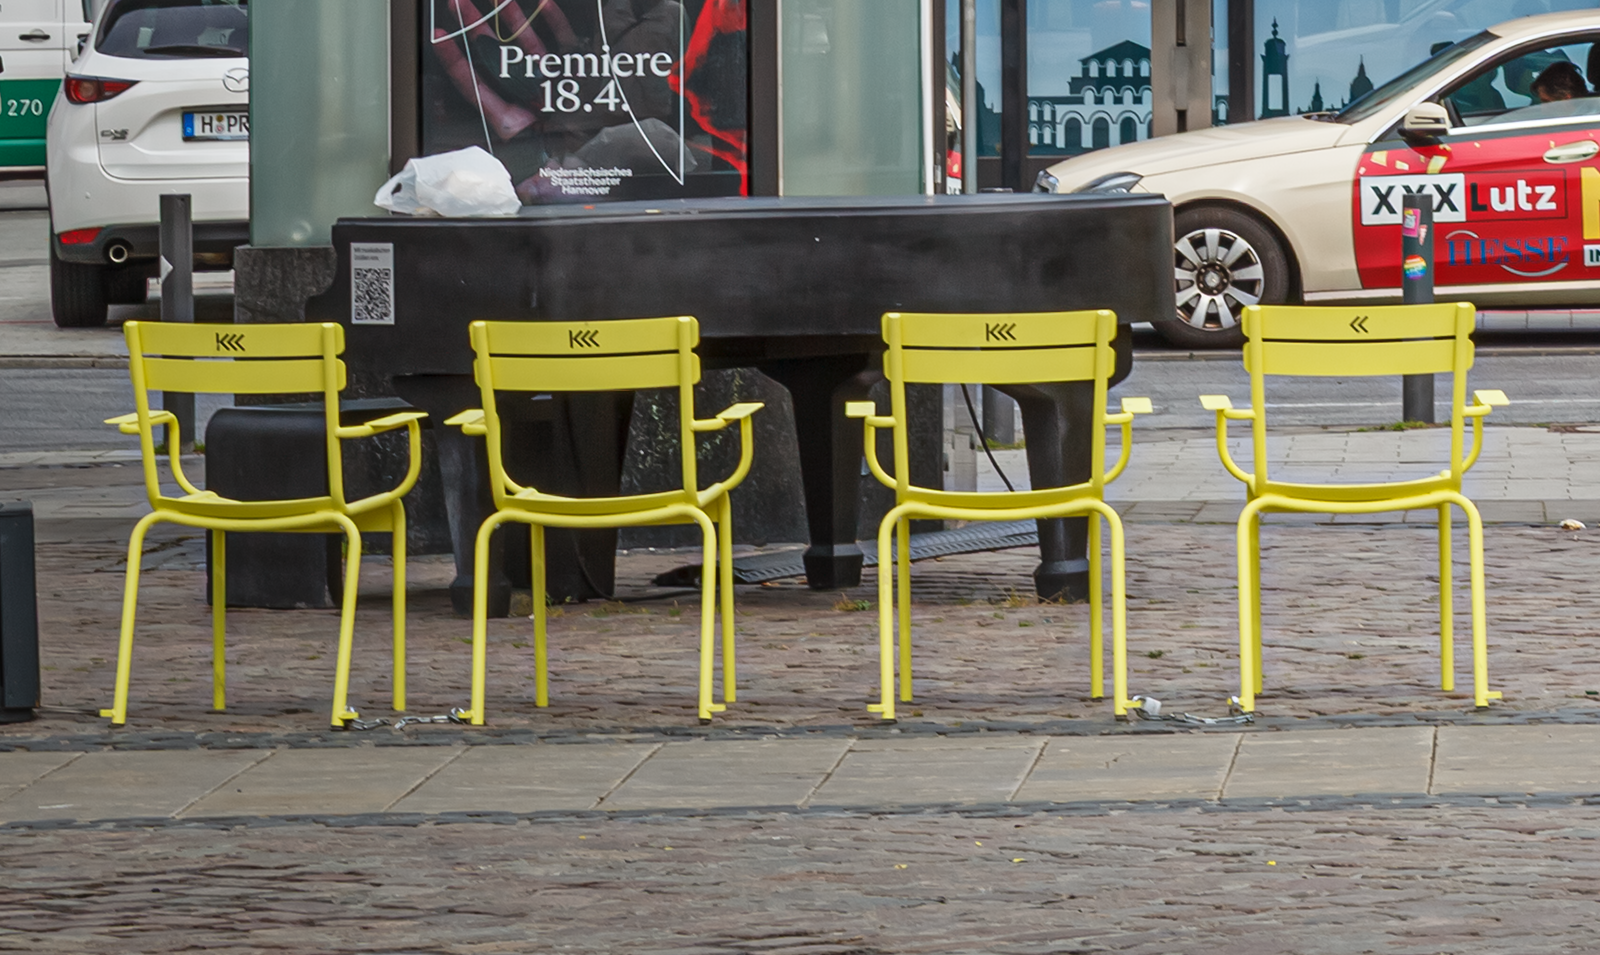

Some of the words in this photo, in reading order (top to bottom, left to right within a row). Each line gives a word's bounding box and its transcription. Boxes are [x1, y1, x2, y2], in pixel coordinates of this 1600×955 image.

[499, 45, 673, 79] Premiere
[539, 79, 630, 113] 18.4.
[7, 98, 43, 117] 270
[201, 114, 214, 133] H
[539, 167, 633, 178] Niedersächsisches
[551, 177, 621, 187] Staatstheater
[561, 185, 611, 195] Hannover
